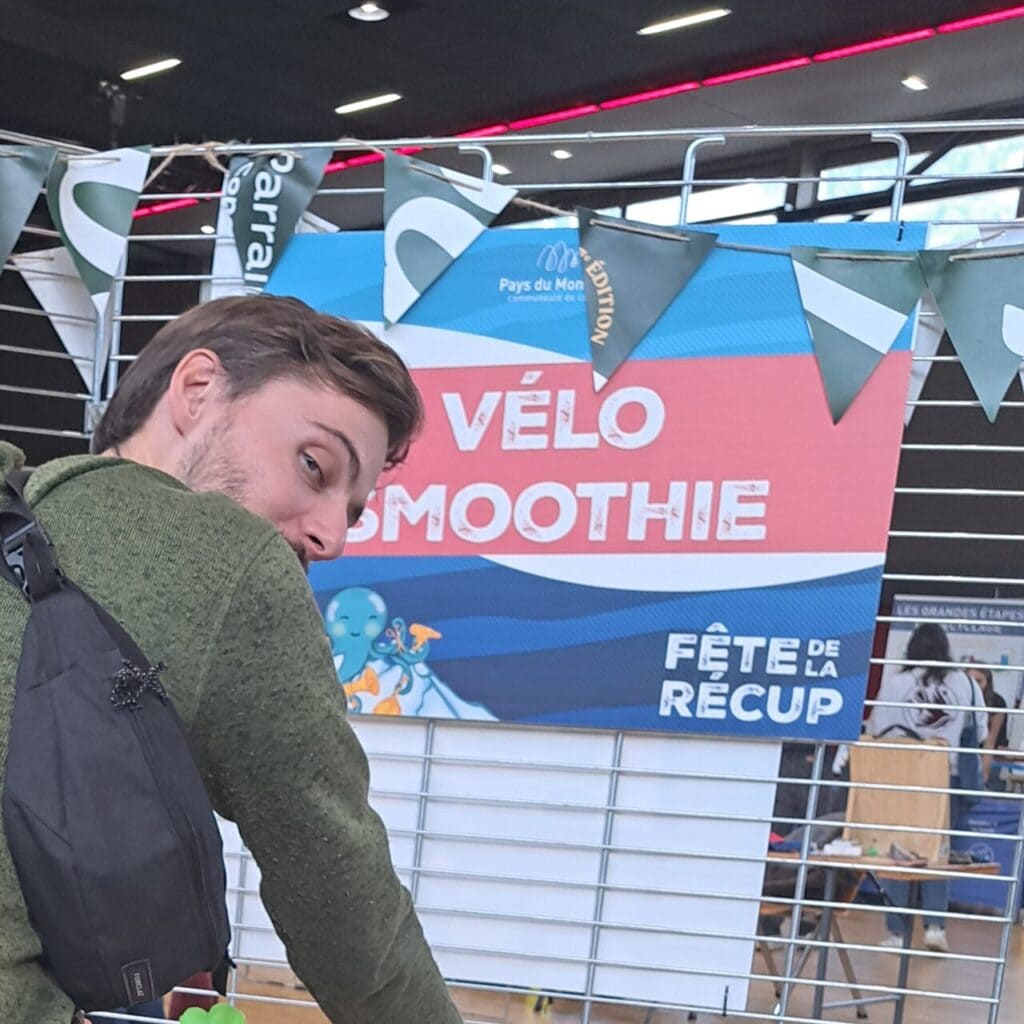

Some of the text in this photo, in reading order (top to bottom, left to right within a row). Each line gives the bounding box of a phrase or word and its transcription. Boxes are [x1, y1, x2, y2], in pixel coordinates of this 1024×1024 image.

[499, 277, 531, 294] Pays
[534, 277, 552, 291] du
[585, 259, 615, 346] ÉDITION
[441, 370, 666, 451] VÉLO
[896, 604, 920, 616] LES
[920, 605, 976, 618] GRANDES
[664, 621, 841, 676] FÊTE DE
[804, 659, 839, 678] LA
[658, 671, 843, 725] RÉCUP
